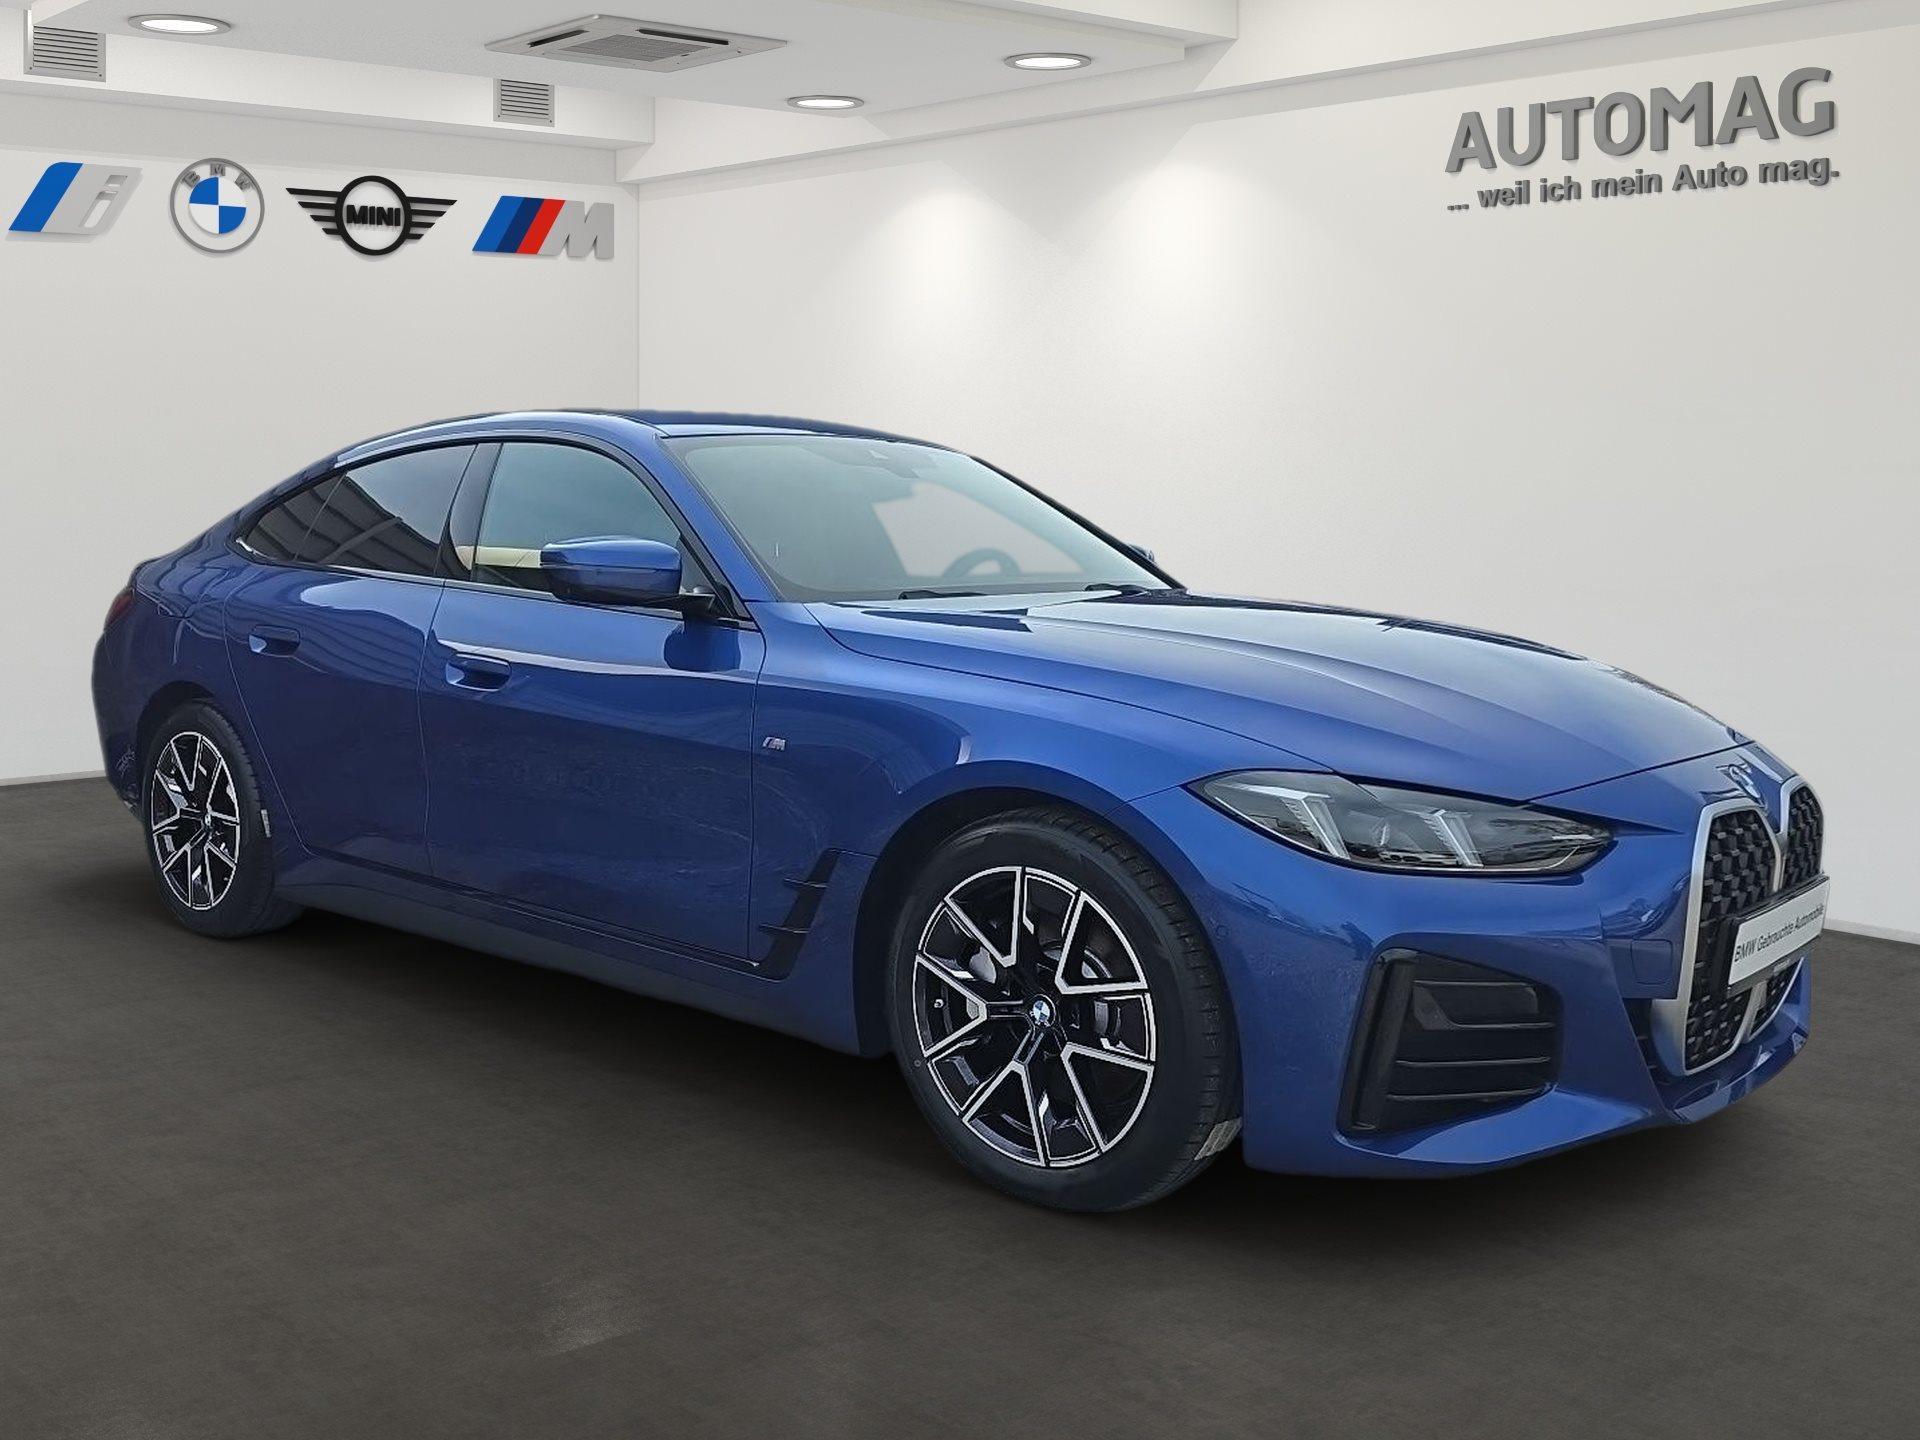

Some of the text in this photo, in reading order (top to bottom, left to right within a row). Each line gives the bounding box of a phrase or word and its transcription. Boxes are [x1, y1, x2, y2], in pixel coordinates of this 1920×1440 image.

[1445, 67, 1835, 173] AUTOMAG
[182, 163, 252, 191] BMW
[1477, 179, 1530, 207] weil
[1539, 175, 1581, 203] ich
[1592, 169, 1662, 198] mein
[1672, 160, 1748, 191] Auto
[1758, 157, 1840, 187] mag.
[346, 204, 401, 227] MINI
[1734, 938, 1758, 963] BMW
